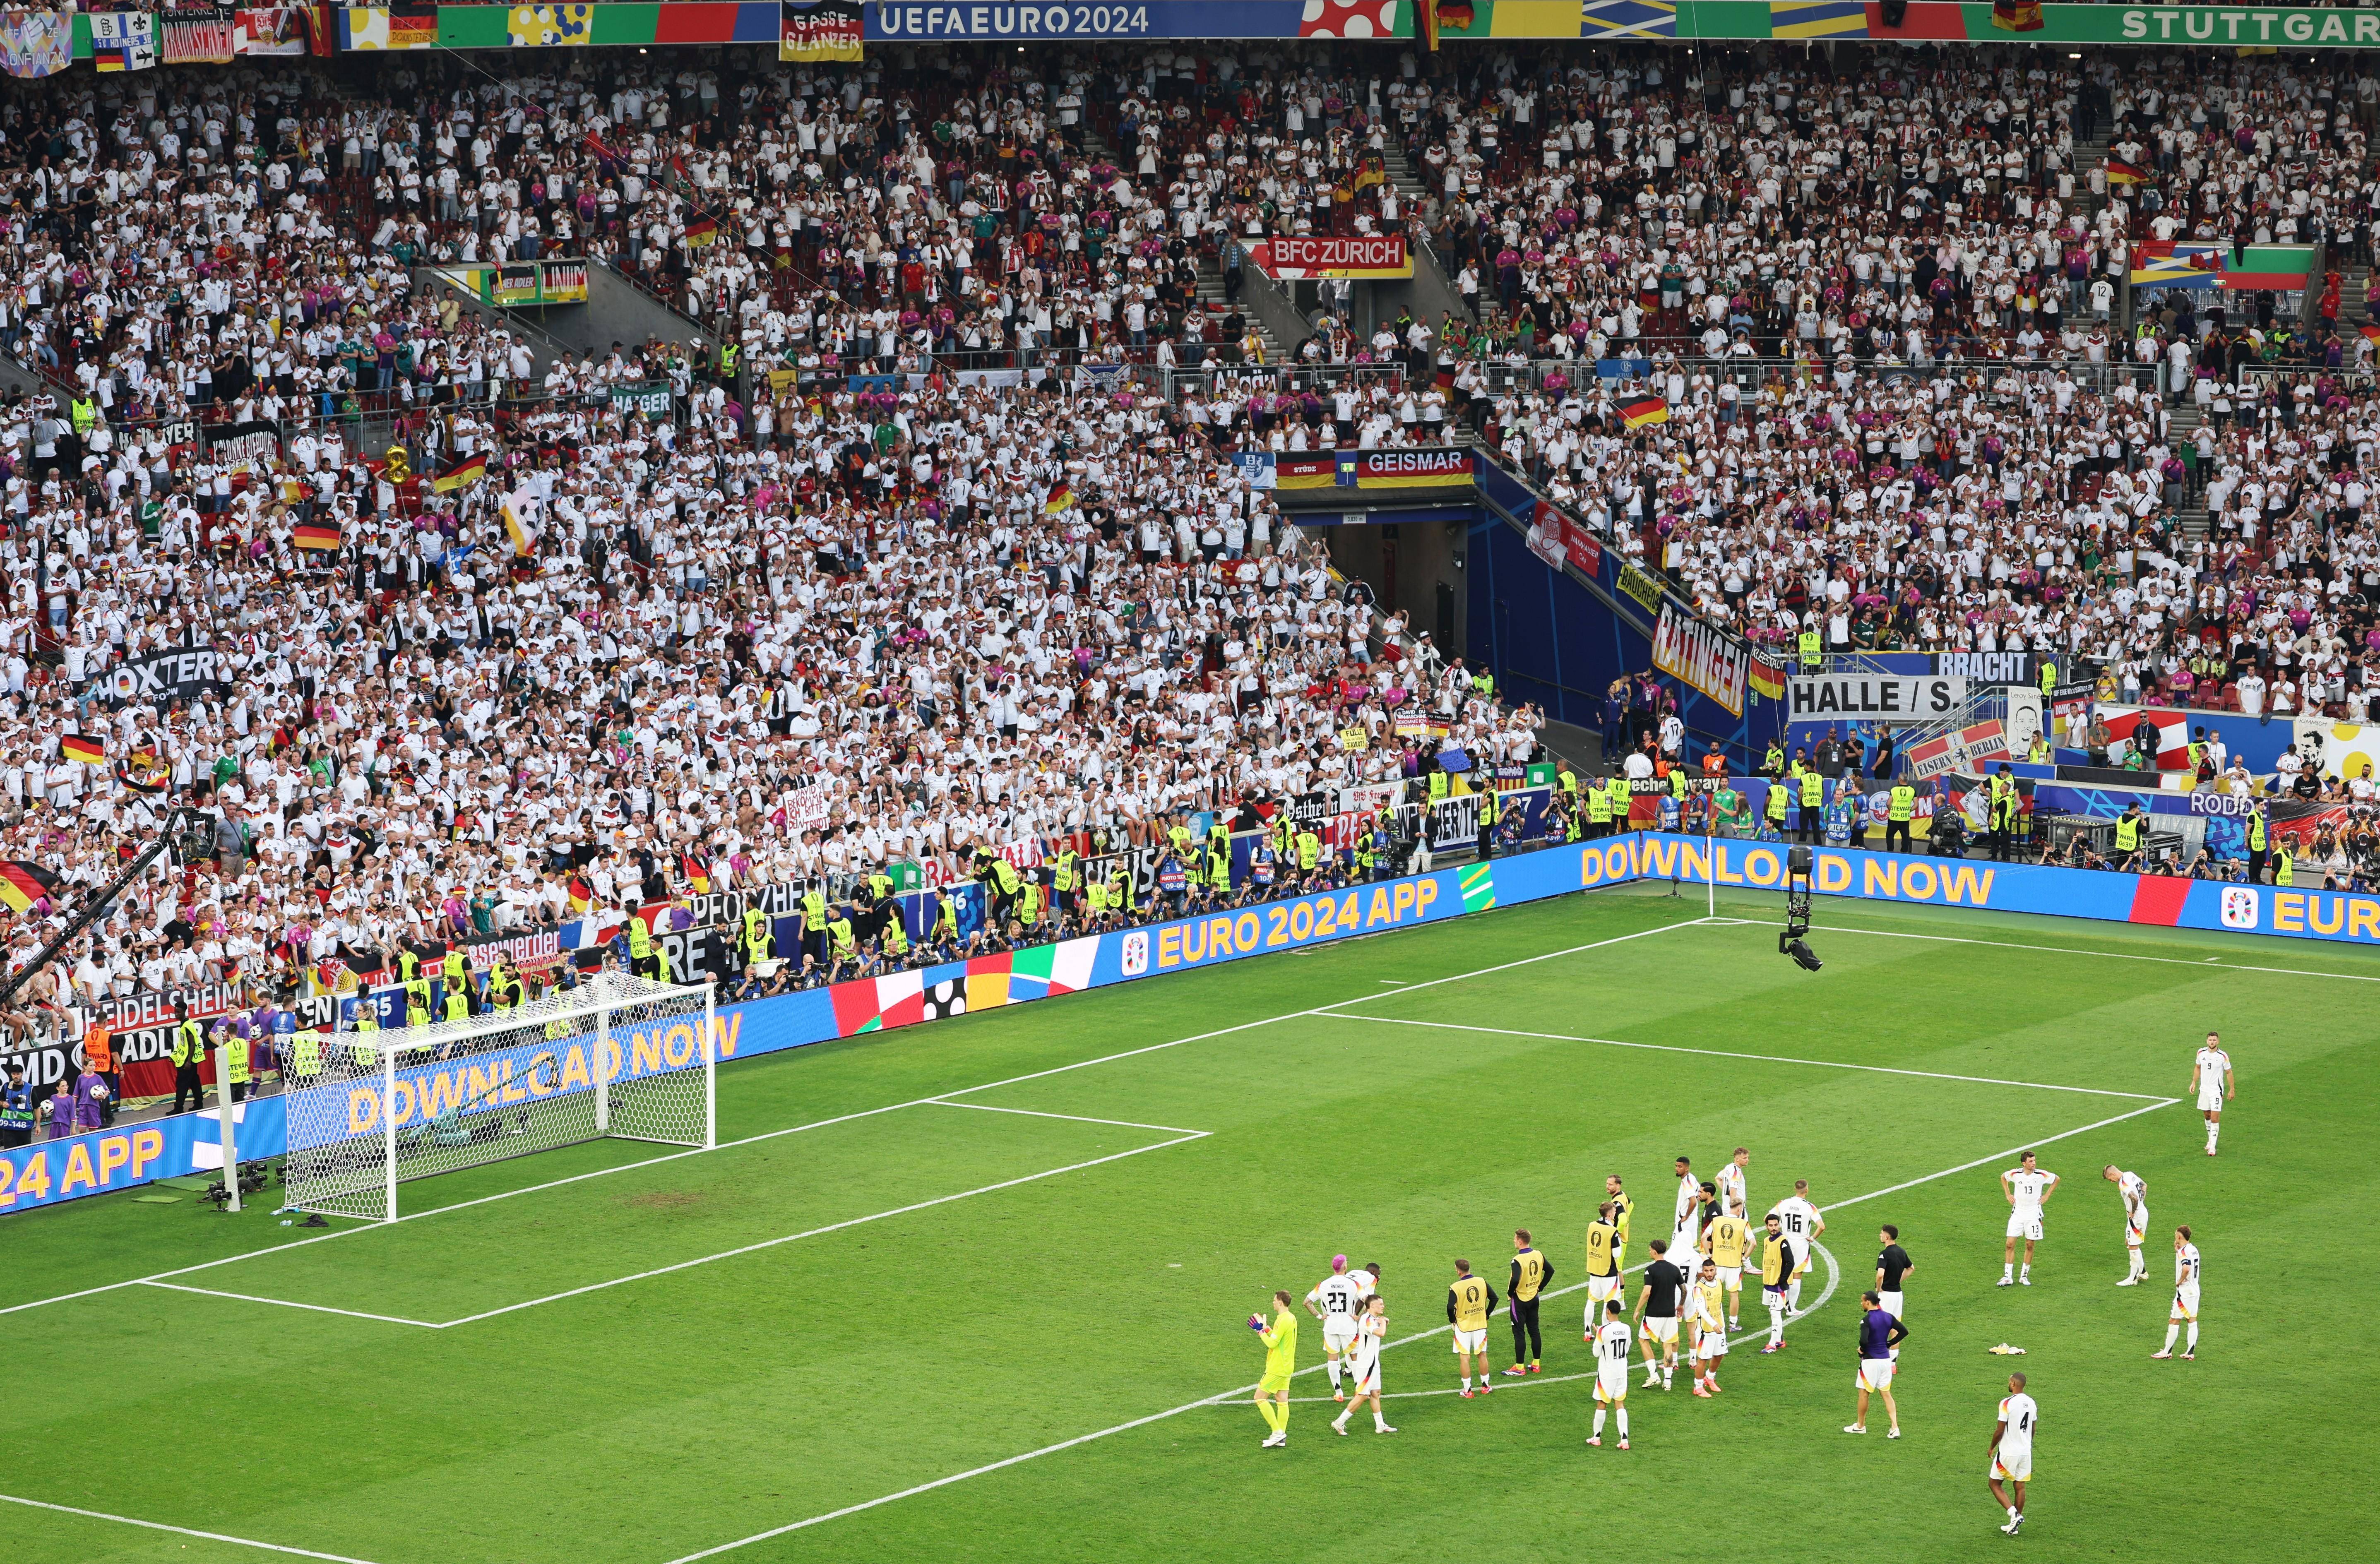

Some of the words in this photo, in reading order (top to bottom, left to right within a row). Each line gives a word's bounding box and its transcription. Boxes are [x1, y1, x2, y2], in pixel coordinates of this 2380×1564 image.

[794, 11, 856, 31] GASSE-
[880, 7, 966, 34] UEFA
[972, 7, 1070, 34] EURO
[1074, 7, 1149, 33] 2024
[786, 30, 860, 51] GLÄNZER
[7, 51, 65, 66] ONFIANZA
[1275, 240, 1317, 264] BFC
[1321, 237, 1399, 264] ZÜRICH
[514, 277, 534, 288] ADLER
[542, 266, 588, 293] LINUM
[2098, 286, 2106, 297] 12
[1369, 452, 1462, 472] GEISMAR
[1654, 603, 1748, 712] RATINGEN
[1752, 646, 1786, 670] KLEESTADT
[1939, 652, 2027, 682] BRACHT
[99, 651, 215, 704] HÖXTER
[1793, 681, 1899, 713] HALLE
[1930, 681, 1960, 712] S.
[2011, 692, 2026, 700] Leroy
[2055, 704, 2070, 714] DANK
[1670, 723, 1679, 737] 17
[1916, 754, 1953, 776] EISERN
[1969, 736, 2006, 757] BERLIN
[787, 792, 823, 810] BEKOMME
[795, 785, 816, 797] DAVID
[789, 807, 800, 819] ICH
[805, 802, 823, 817] BITTE
[789, 819, 804, 830] DEIN
[2116, 833, 2134, 841] EWARD
[1582, 839, 1852, 892] DOWNLOAD
[1864, 858, 1994, 905] NOW
[1158, 912, 1261, 968] EURO
[1267, 892, 1360, 947] 2024
[1366, 877, 1438, 927] APP
[84, 982, 243, 1032] HEIDELSHEIM
[349, 1040, 621, 1135] DOWNLOAD
[631, 1013, 741, 1076] NOW
[0, 1119, 27, 1129] 09-148
[7, 1111, 19, 1119] TV
[60, 1129, 164, 1195] APP
[2024, 1186, 2033, 1194] 13
[1785, 1213, 1802, 1233] 16
[1327, 1292, 1346, 1313] 23
[1611, 1338, 1627, 1360] 10
[2019, 1411, 2029, 1430] 4
